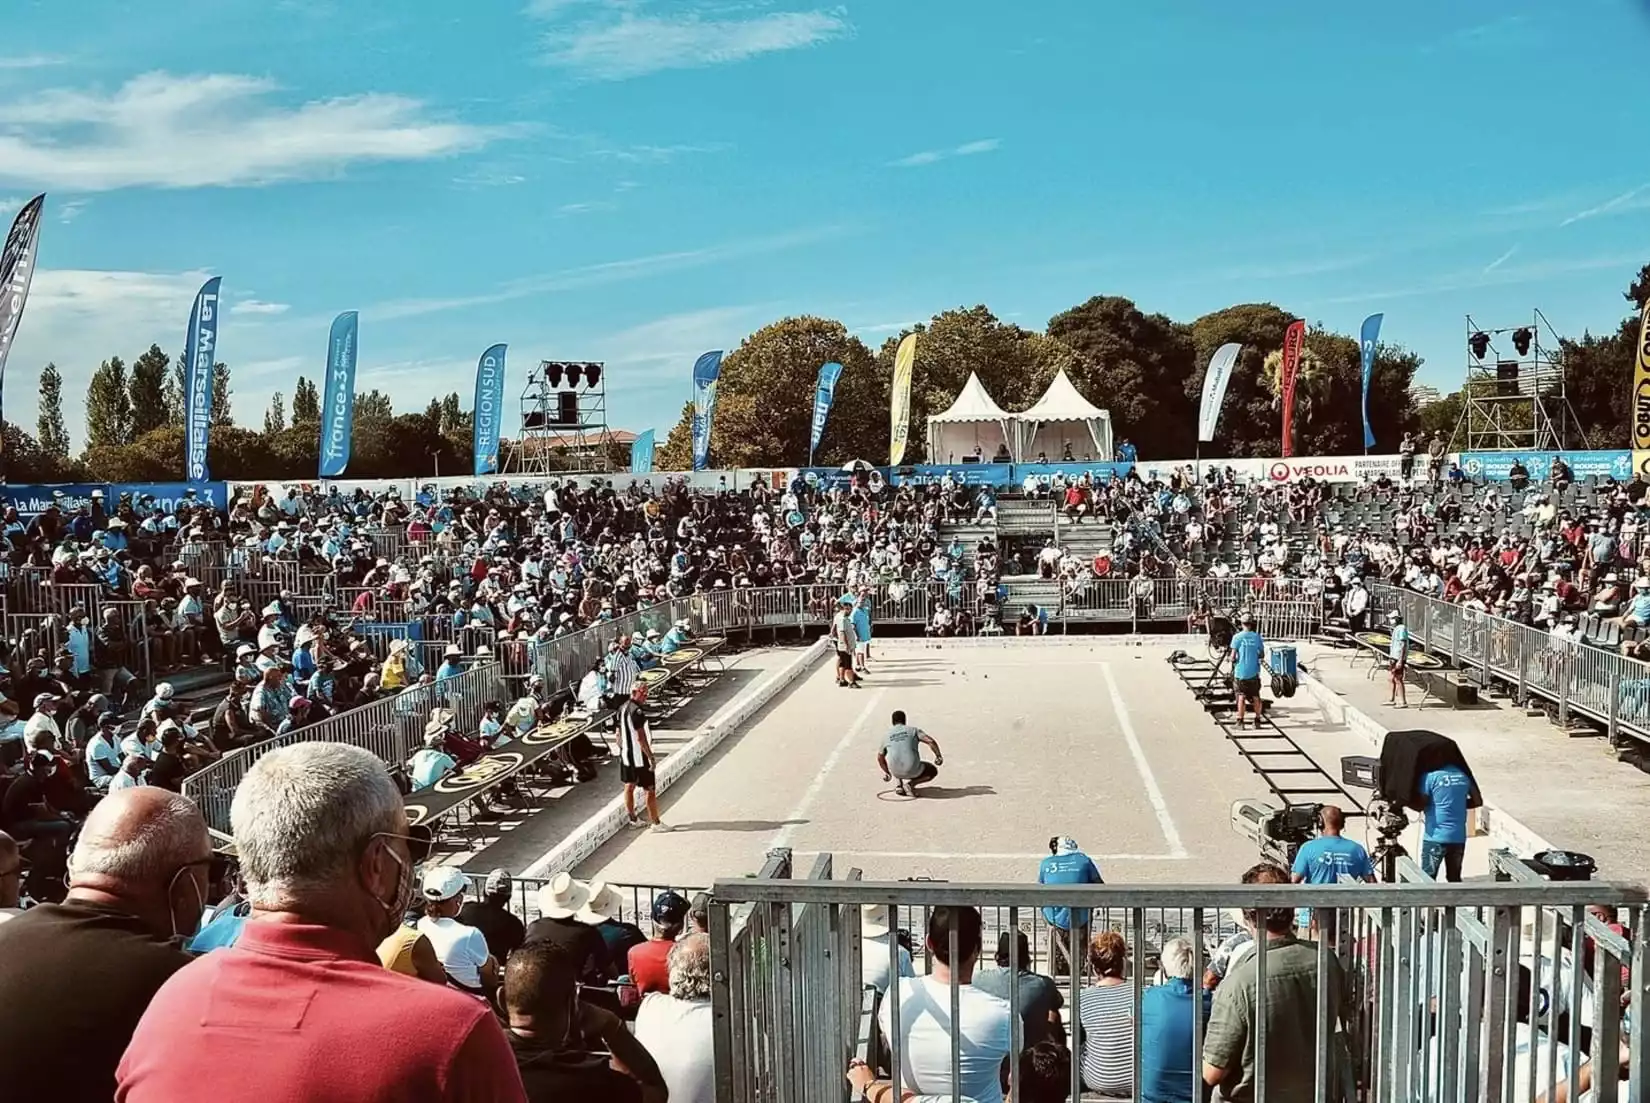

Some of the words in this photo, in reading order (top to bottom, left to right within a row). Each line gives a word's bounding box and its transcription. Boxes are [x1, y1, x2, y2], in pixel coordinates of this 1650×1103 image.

[201, 294, 217, 322] La
[484, 356, 497, 386] SUD
[193, 327, 214, 479] Marseillaise
[1293, 464, 1349, 477] VEOLIA
[14, 497, 26, 512] La
